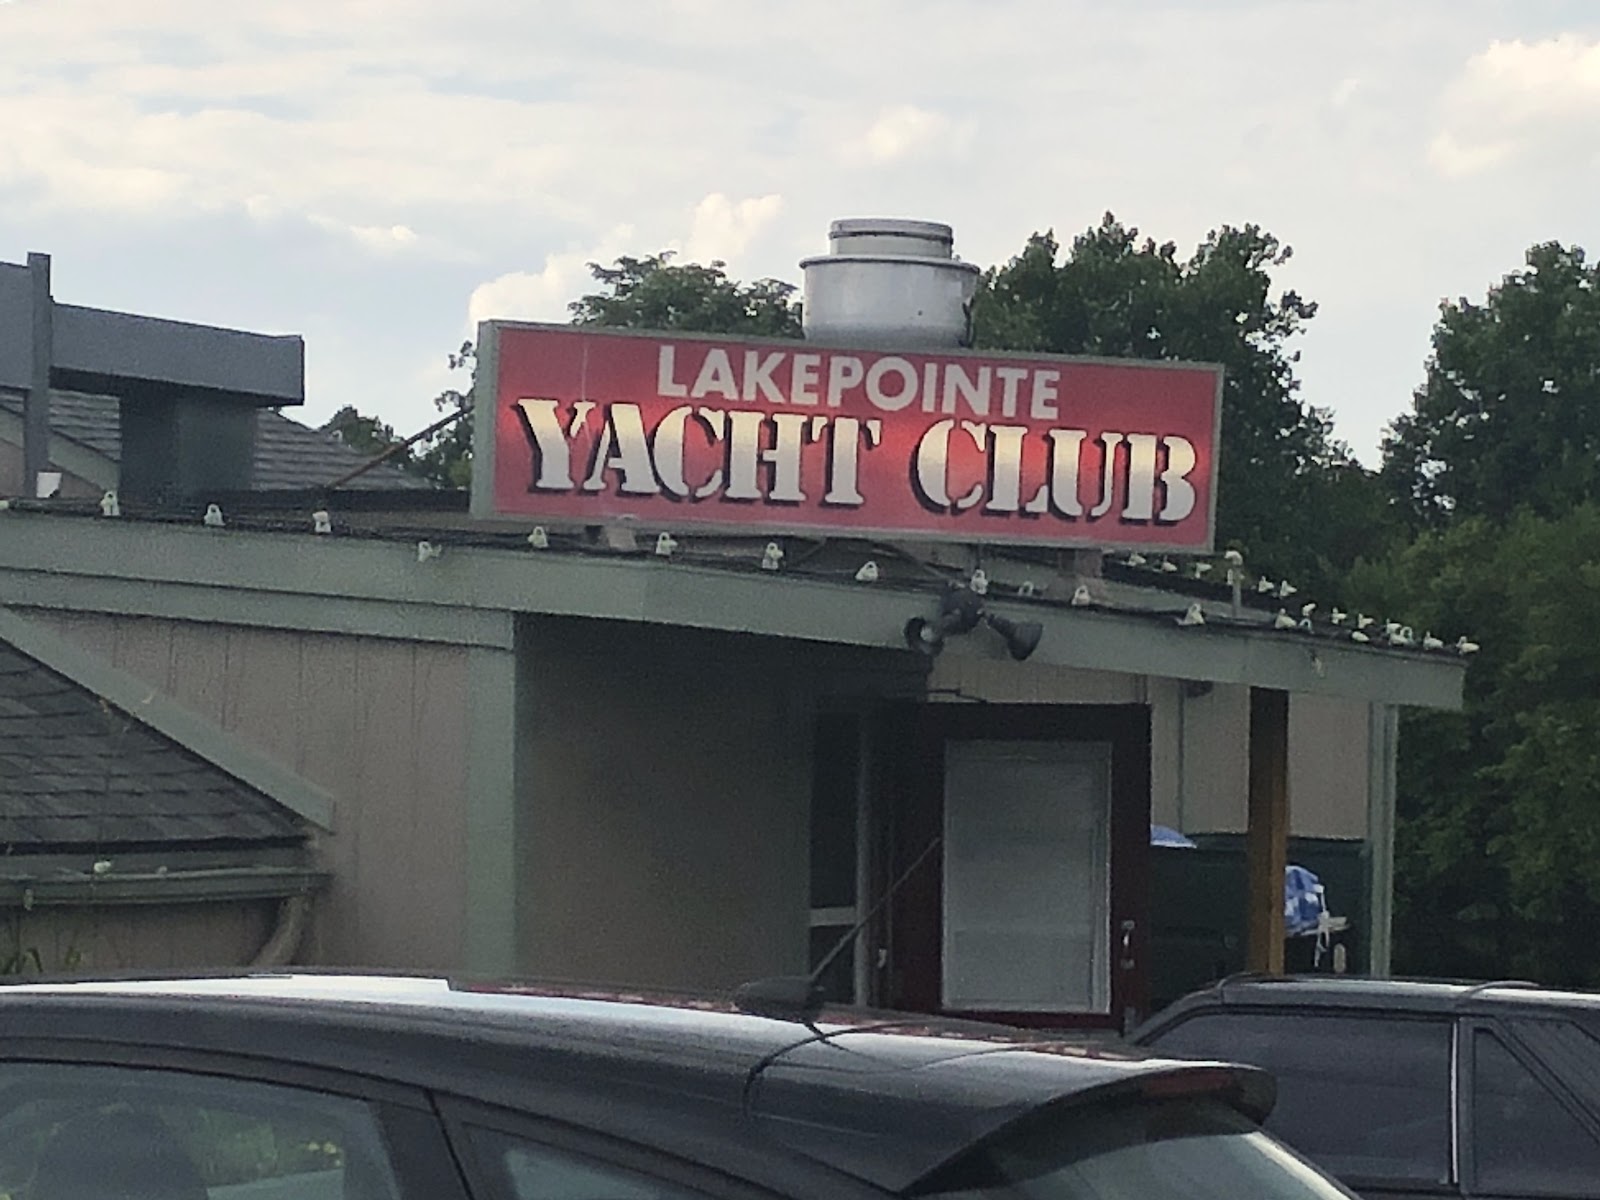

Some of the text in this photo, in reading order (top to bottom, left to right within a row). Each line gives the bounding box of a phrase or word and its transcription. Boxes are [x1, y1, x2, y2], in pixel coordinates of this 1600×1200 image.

[657, 344, 1061, 420] LAKEPOINTE
[513, 397, 1197, 523] YACHT CLUB
